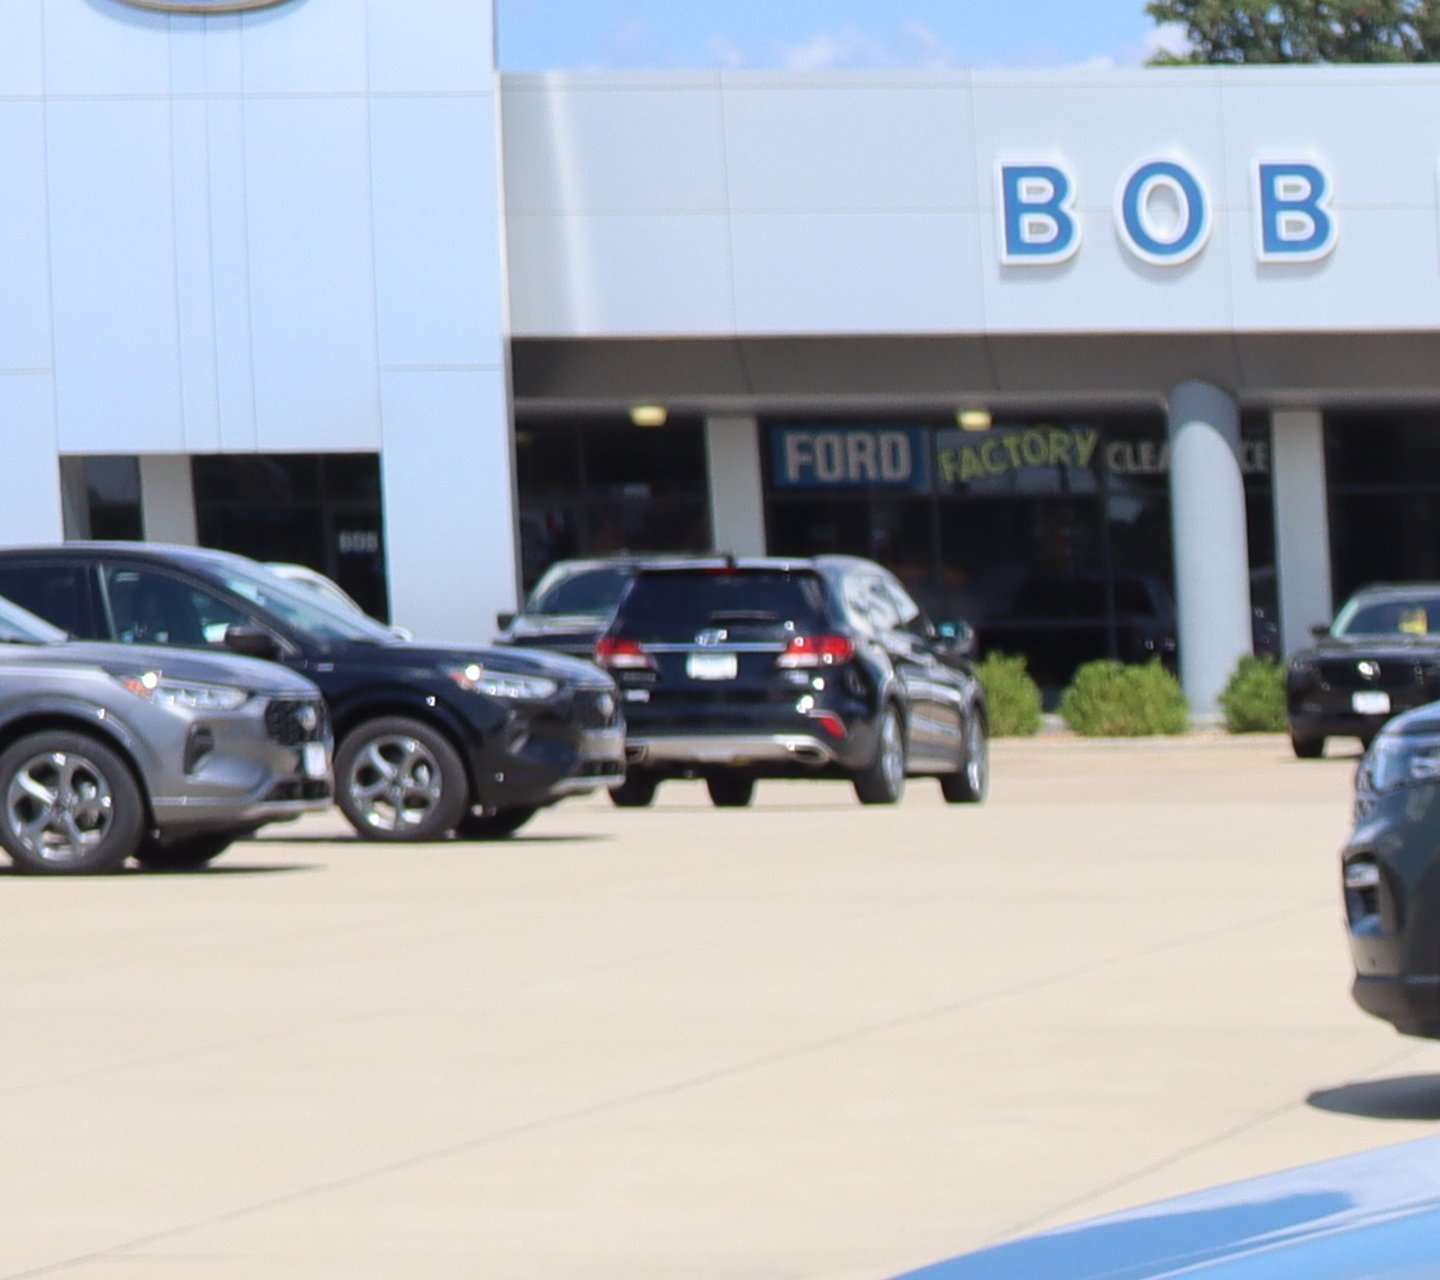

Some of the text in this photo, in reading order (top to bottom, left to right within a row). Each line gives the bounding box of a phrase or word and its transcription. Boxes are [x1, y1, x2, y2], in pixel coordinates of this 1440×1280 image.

[999, 155, 1336, 263] BOB
[785, 431, 913, 484] FORD
[939, 427, 1098, 484] FACTORY
